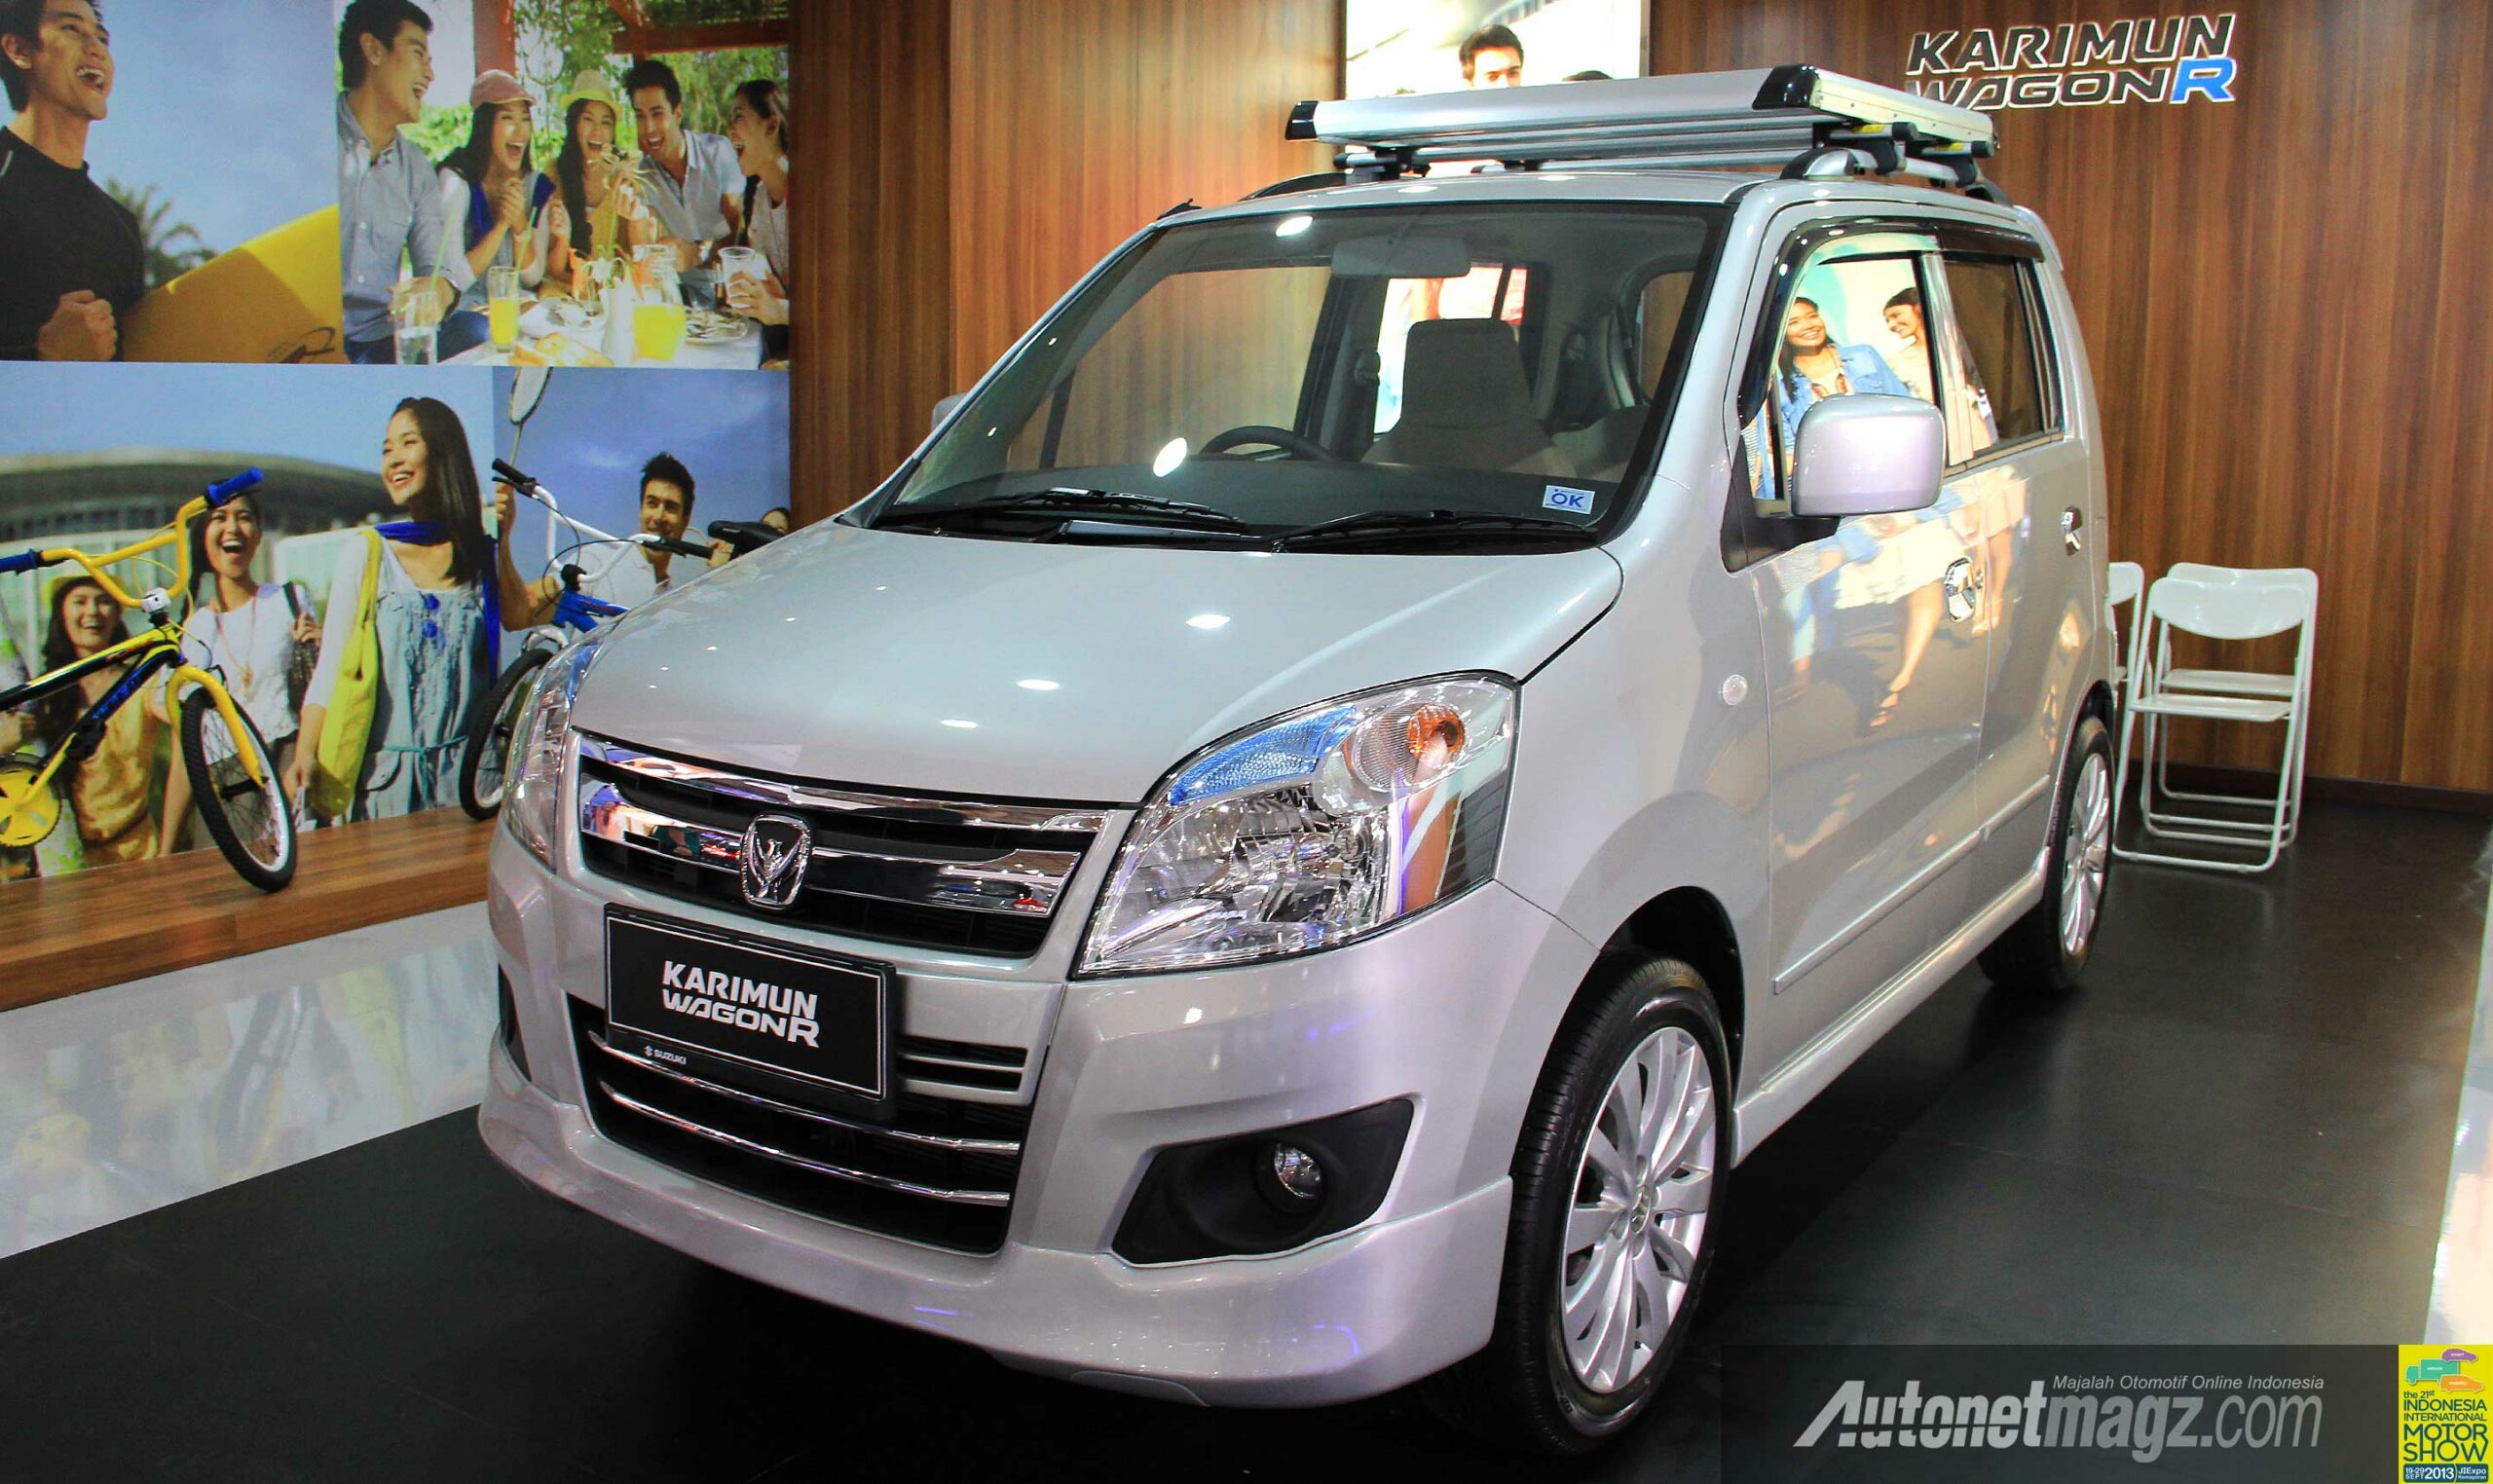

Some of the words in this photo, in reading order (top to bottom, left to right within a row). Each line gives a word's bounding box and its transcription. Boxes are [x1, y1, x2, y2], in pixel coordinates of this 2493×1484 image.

[1906, 13, 2236, 76] KARIMUN
[1551, 492, 1584, 507] OK
[661, 988, 820, 1049] WAGONR
[662, 960, 818, 1019] KARIMUN
[653, 1049, 687, 1065] SUZUKI
